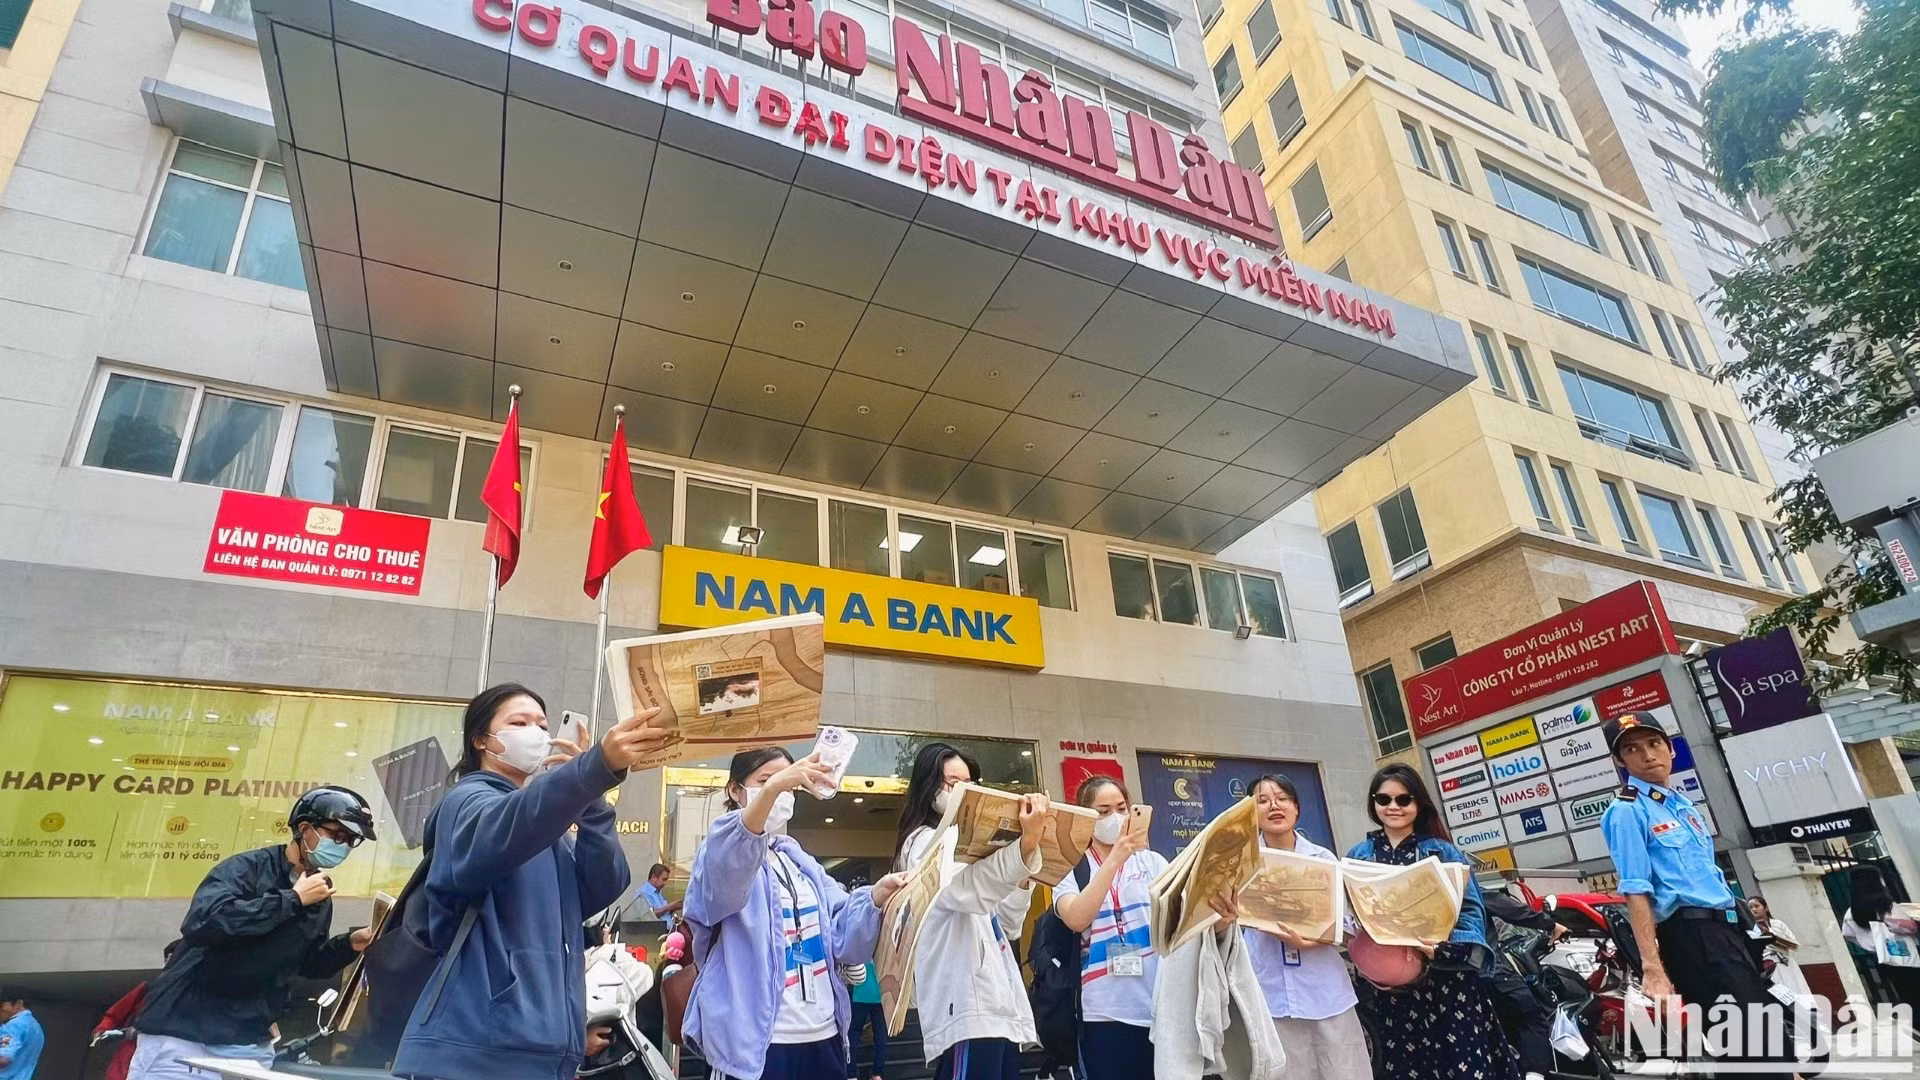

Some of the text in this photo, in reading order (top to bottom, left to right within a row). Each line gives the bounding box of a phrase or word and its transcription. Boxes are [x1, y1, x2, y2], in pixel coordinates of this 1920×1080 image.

[893, 15, 1118, 173] Nhân
[1126, 109, 1275, 233] Dân
[472, 0, 1397, 337] CƠ QUAN ĐẠI DIỆN TẠI KHU VỰC MIỀN NAM
[218, 526, 420, 568] VĂN PHÒNG CHO THUÊ
[213, 552, 241, 565] LIÊN
[243, 555, 259, 569] HỆ
[261, 558, 286, 570] BAN
[288, 560, 320, 575] QUẢN
[341, 568, 367, 580] 0971
[371, 571, 384, 582] 12
[385, 573, 399, 584] 82
[401, 575, 415, 586] 82
[694, 570, 1017, 645] NAM A BANK
[1503, 618, 1584, 660] Đơn Vị Quản Lý
[1463, 614, 1650, 697] CÔNG TY CỔ PHẦN NEST ART
[1529, 677, 1552, 690] Hotline
[1556, 669, 1572, 681] 0971
[1757, 668, 1800, 693] spa
[104, 703, 277, 728] NAM A BANK
[1418, 704, 1459, 726] Nest Art
[1541, 714, 1573, 735] palma
[1486, 737, 1503, 747] NAM
[1509, 728, 1530, 740] BANK
[152, 757, 165, 766] TÍN
[1161, 758, 1216, 769] NAM A BANK
[1744, 751, 1827, 783] VICHY
[1, 770, 330, 798] HAPPY CARD PLATINU
[425, 781, 442, 792] Card
[1500, 788, 1535, 806] MIMS
[1574, 799, 1611, 818] KBVN
[1525, 816, 1543, 828] ATS
[1804, 819, 1851, 835] THAIYEN
[67, 838, 97, 848] 100%
[1457, 828, 1501, 846] Cominix
[163, 851, 176, 860] 01
